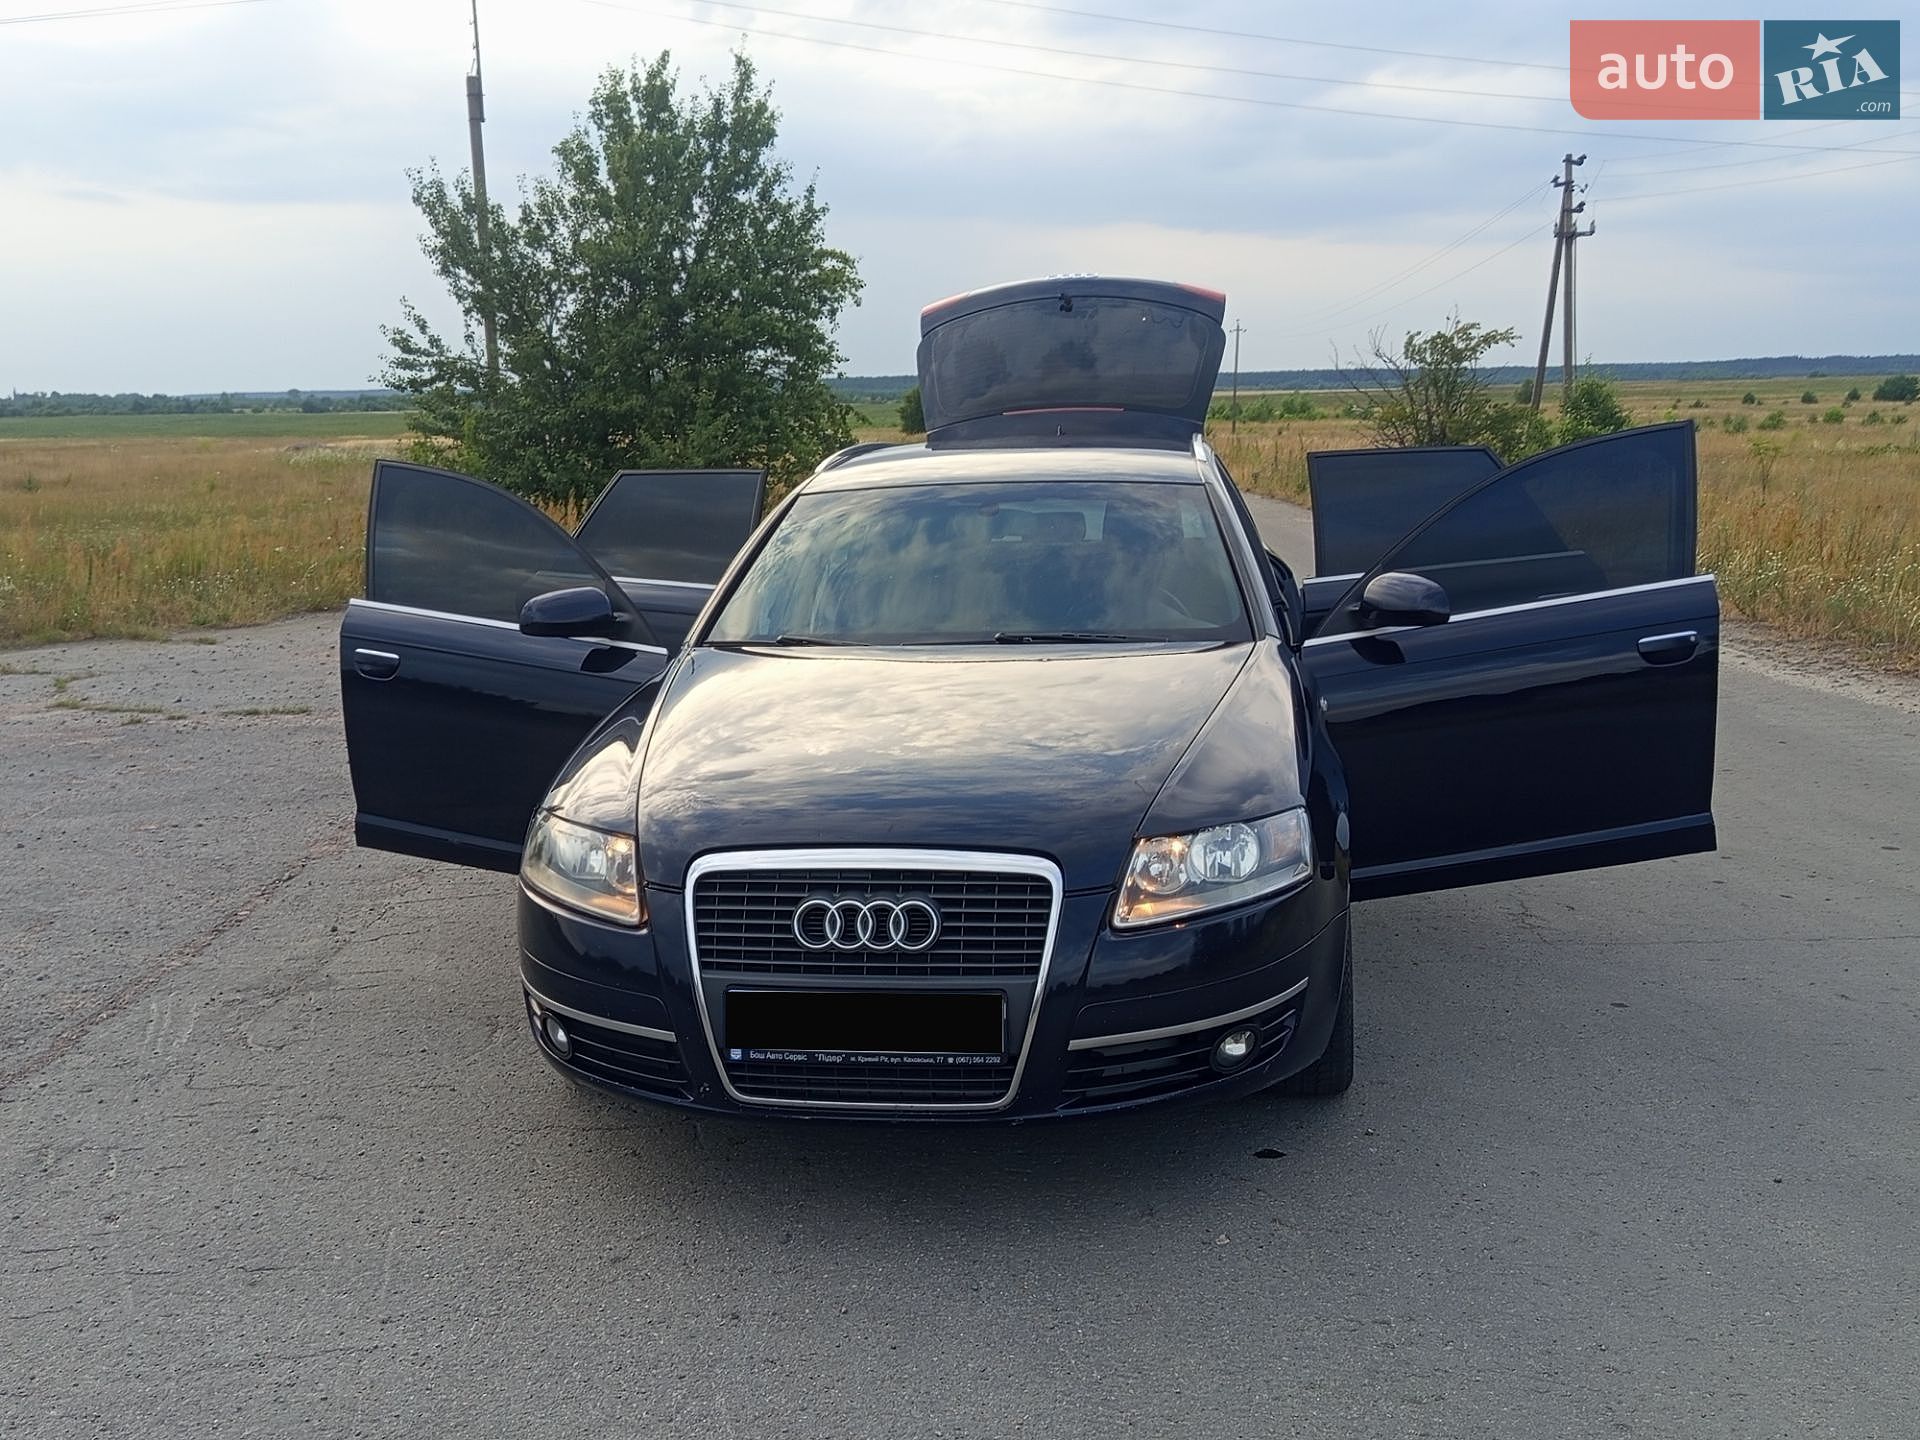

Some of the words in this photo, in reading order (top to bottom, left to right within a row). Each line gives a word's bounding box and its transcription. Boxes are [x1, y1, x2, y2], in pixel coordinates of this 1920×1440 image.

[750, 1050, 765, 1059] Бош
[766, 1051, 783, 1060] Авто
[784, 1052, 808, 1062] Сервіс
